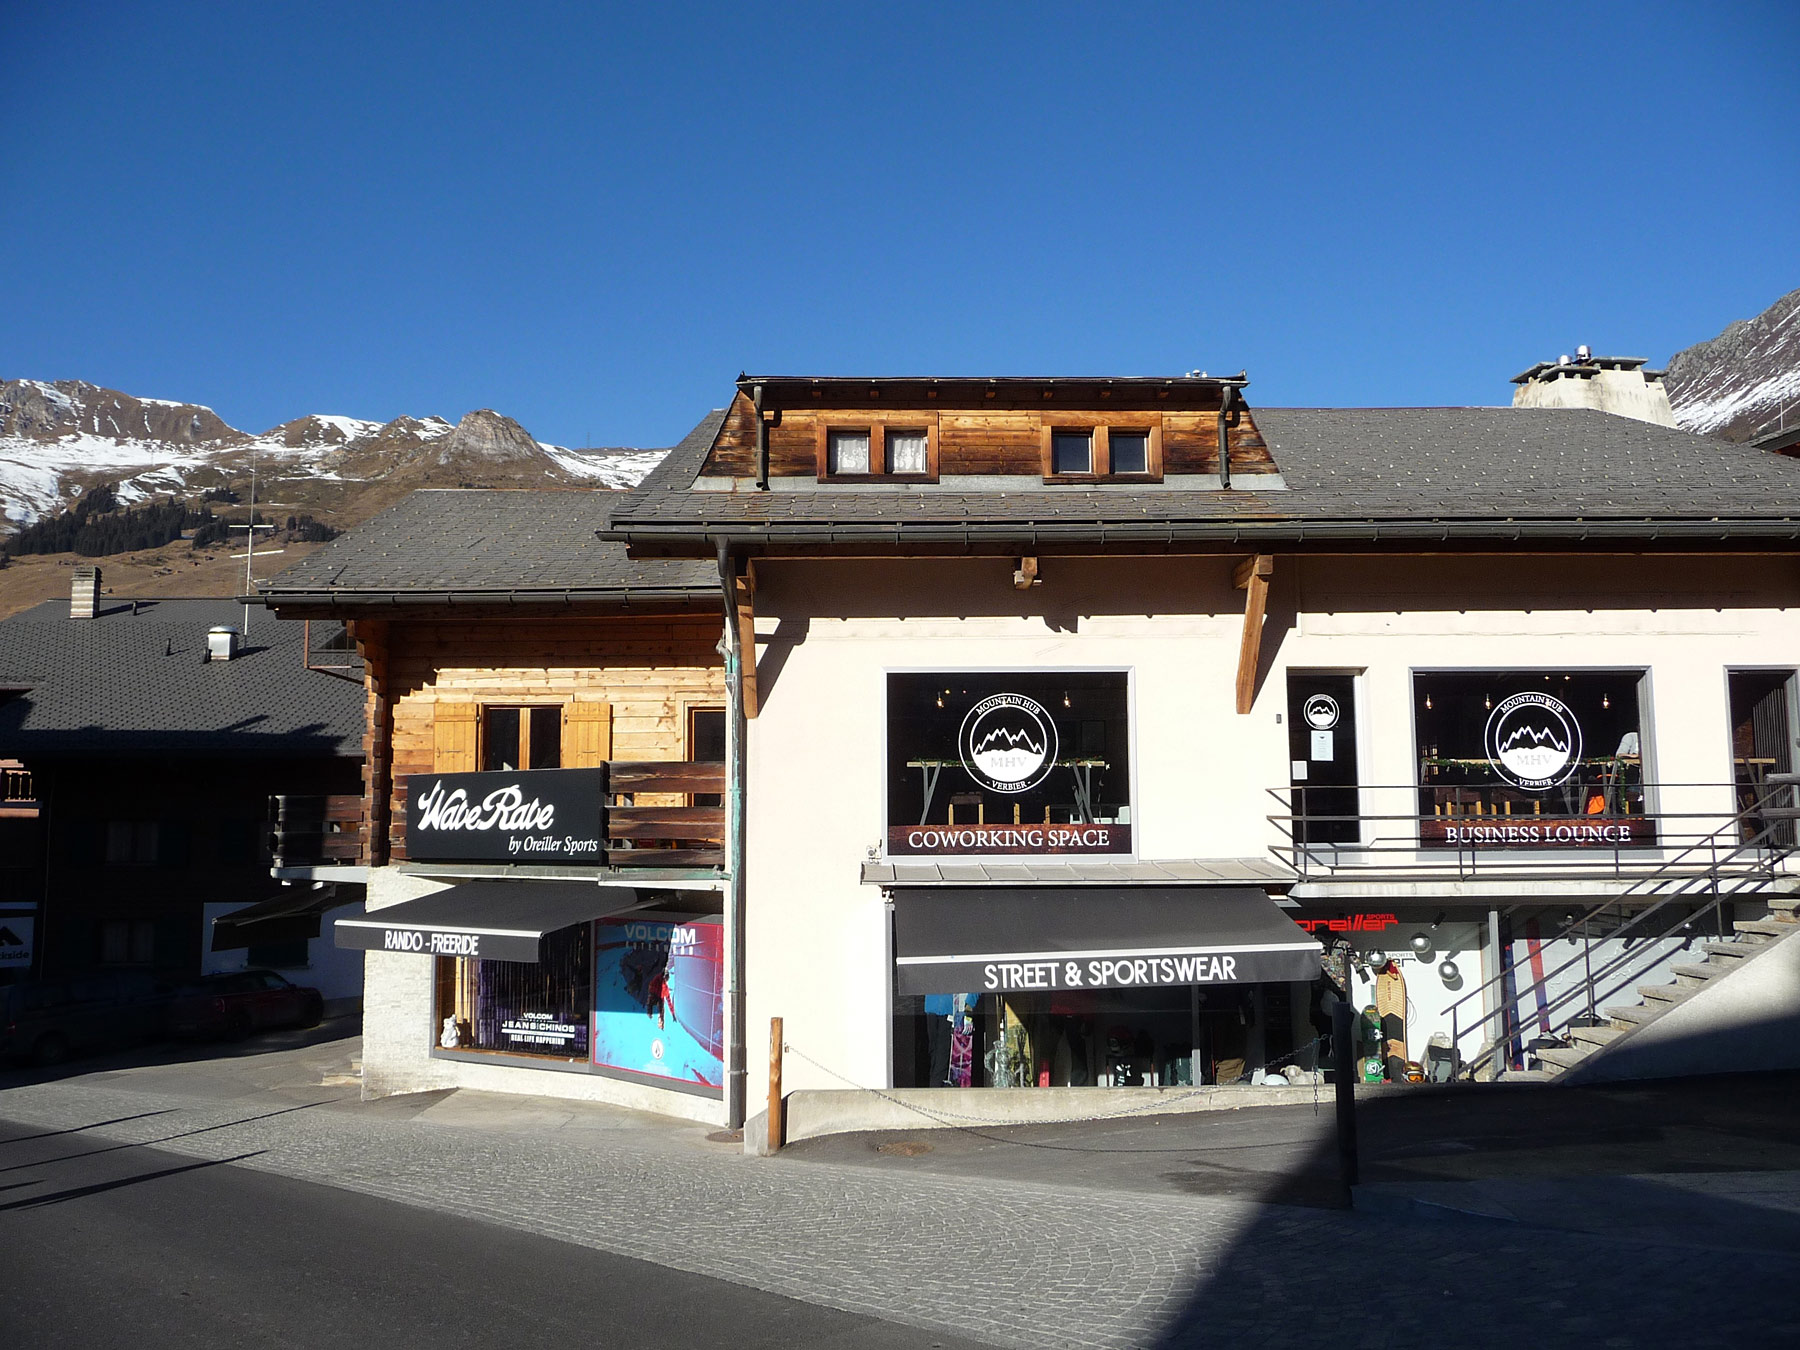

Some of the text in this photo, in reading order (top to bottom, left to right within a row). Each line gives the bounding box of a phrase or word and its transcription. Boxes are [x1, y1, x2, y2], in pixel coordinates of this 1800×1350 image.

[976, 695, 1041, 716] MOUNTAIN HUB
[1501, 692, 1564, 714] MOUNTAIN HUB
[990, 756, 1028, 769] MHV
[1516, 754, 1553, 767] MHV
[990, 779, 1028, 792] VERBIER
[908, 829, 1110, 849] COWORKING SPACE
[1445, 825, 1631, 844] BUSINESS LOUNGE
[508, 835, 598, 855] by Oreiller Sports
[384, 930, 423, 951] RANDO
[624, 924, 696, 944] VOLCOM
[984, 956, 1237, 990] STREET & SPORTSWEAR
[502, 1020, 575, 1033] JEANS CHINOS
[523, 1012, 553, 1021] VOLCOM
